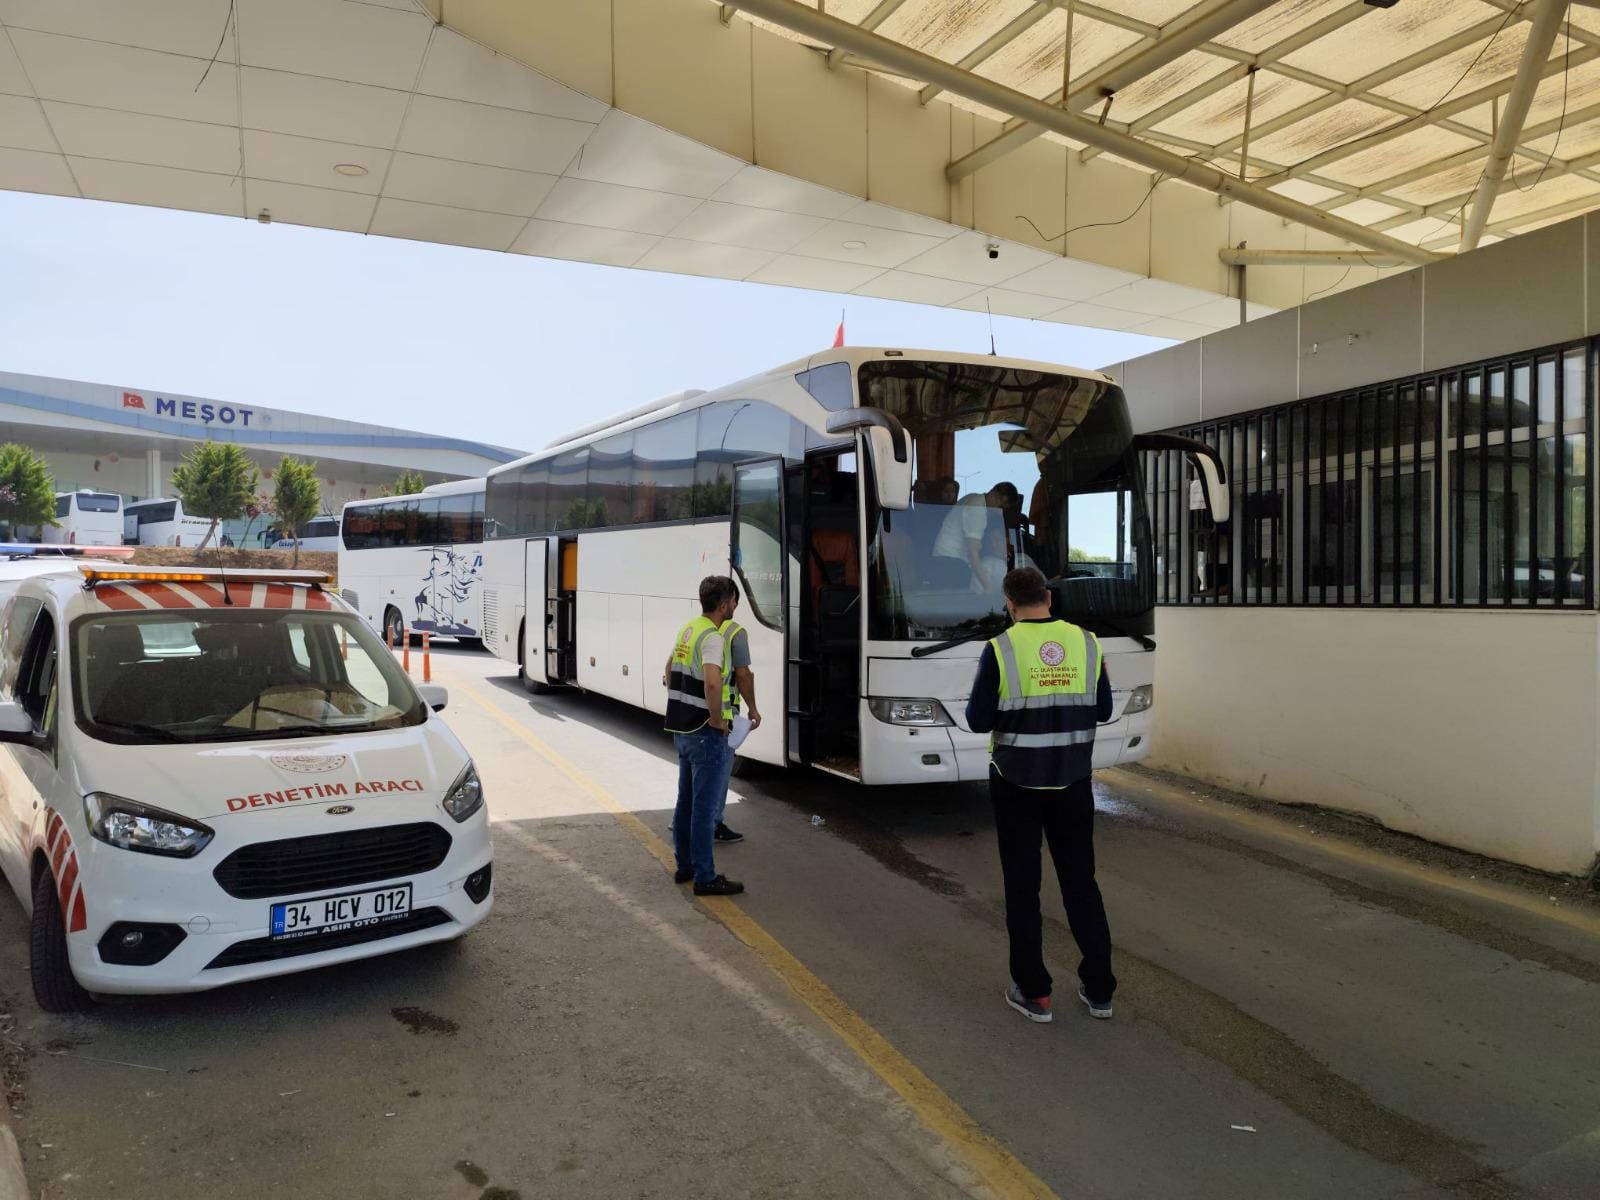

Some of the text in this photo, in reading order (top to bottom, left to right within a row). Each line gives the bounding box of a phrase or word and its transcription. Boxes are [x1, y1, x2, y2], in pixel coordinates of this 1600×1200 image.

[156, 397, 253, 425] MEŞOT
[226, 780, 424, 812] DENETİM ARACI
[274, 921, 284, 929] TR
[287, 905, 311, 928] 34
[324, 897, 361, 922] HCV
[374, 890, 405, 914] 012
[354, 917, 379, 927] OTO
